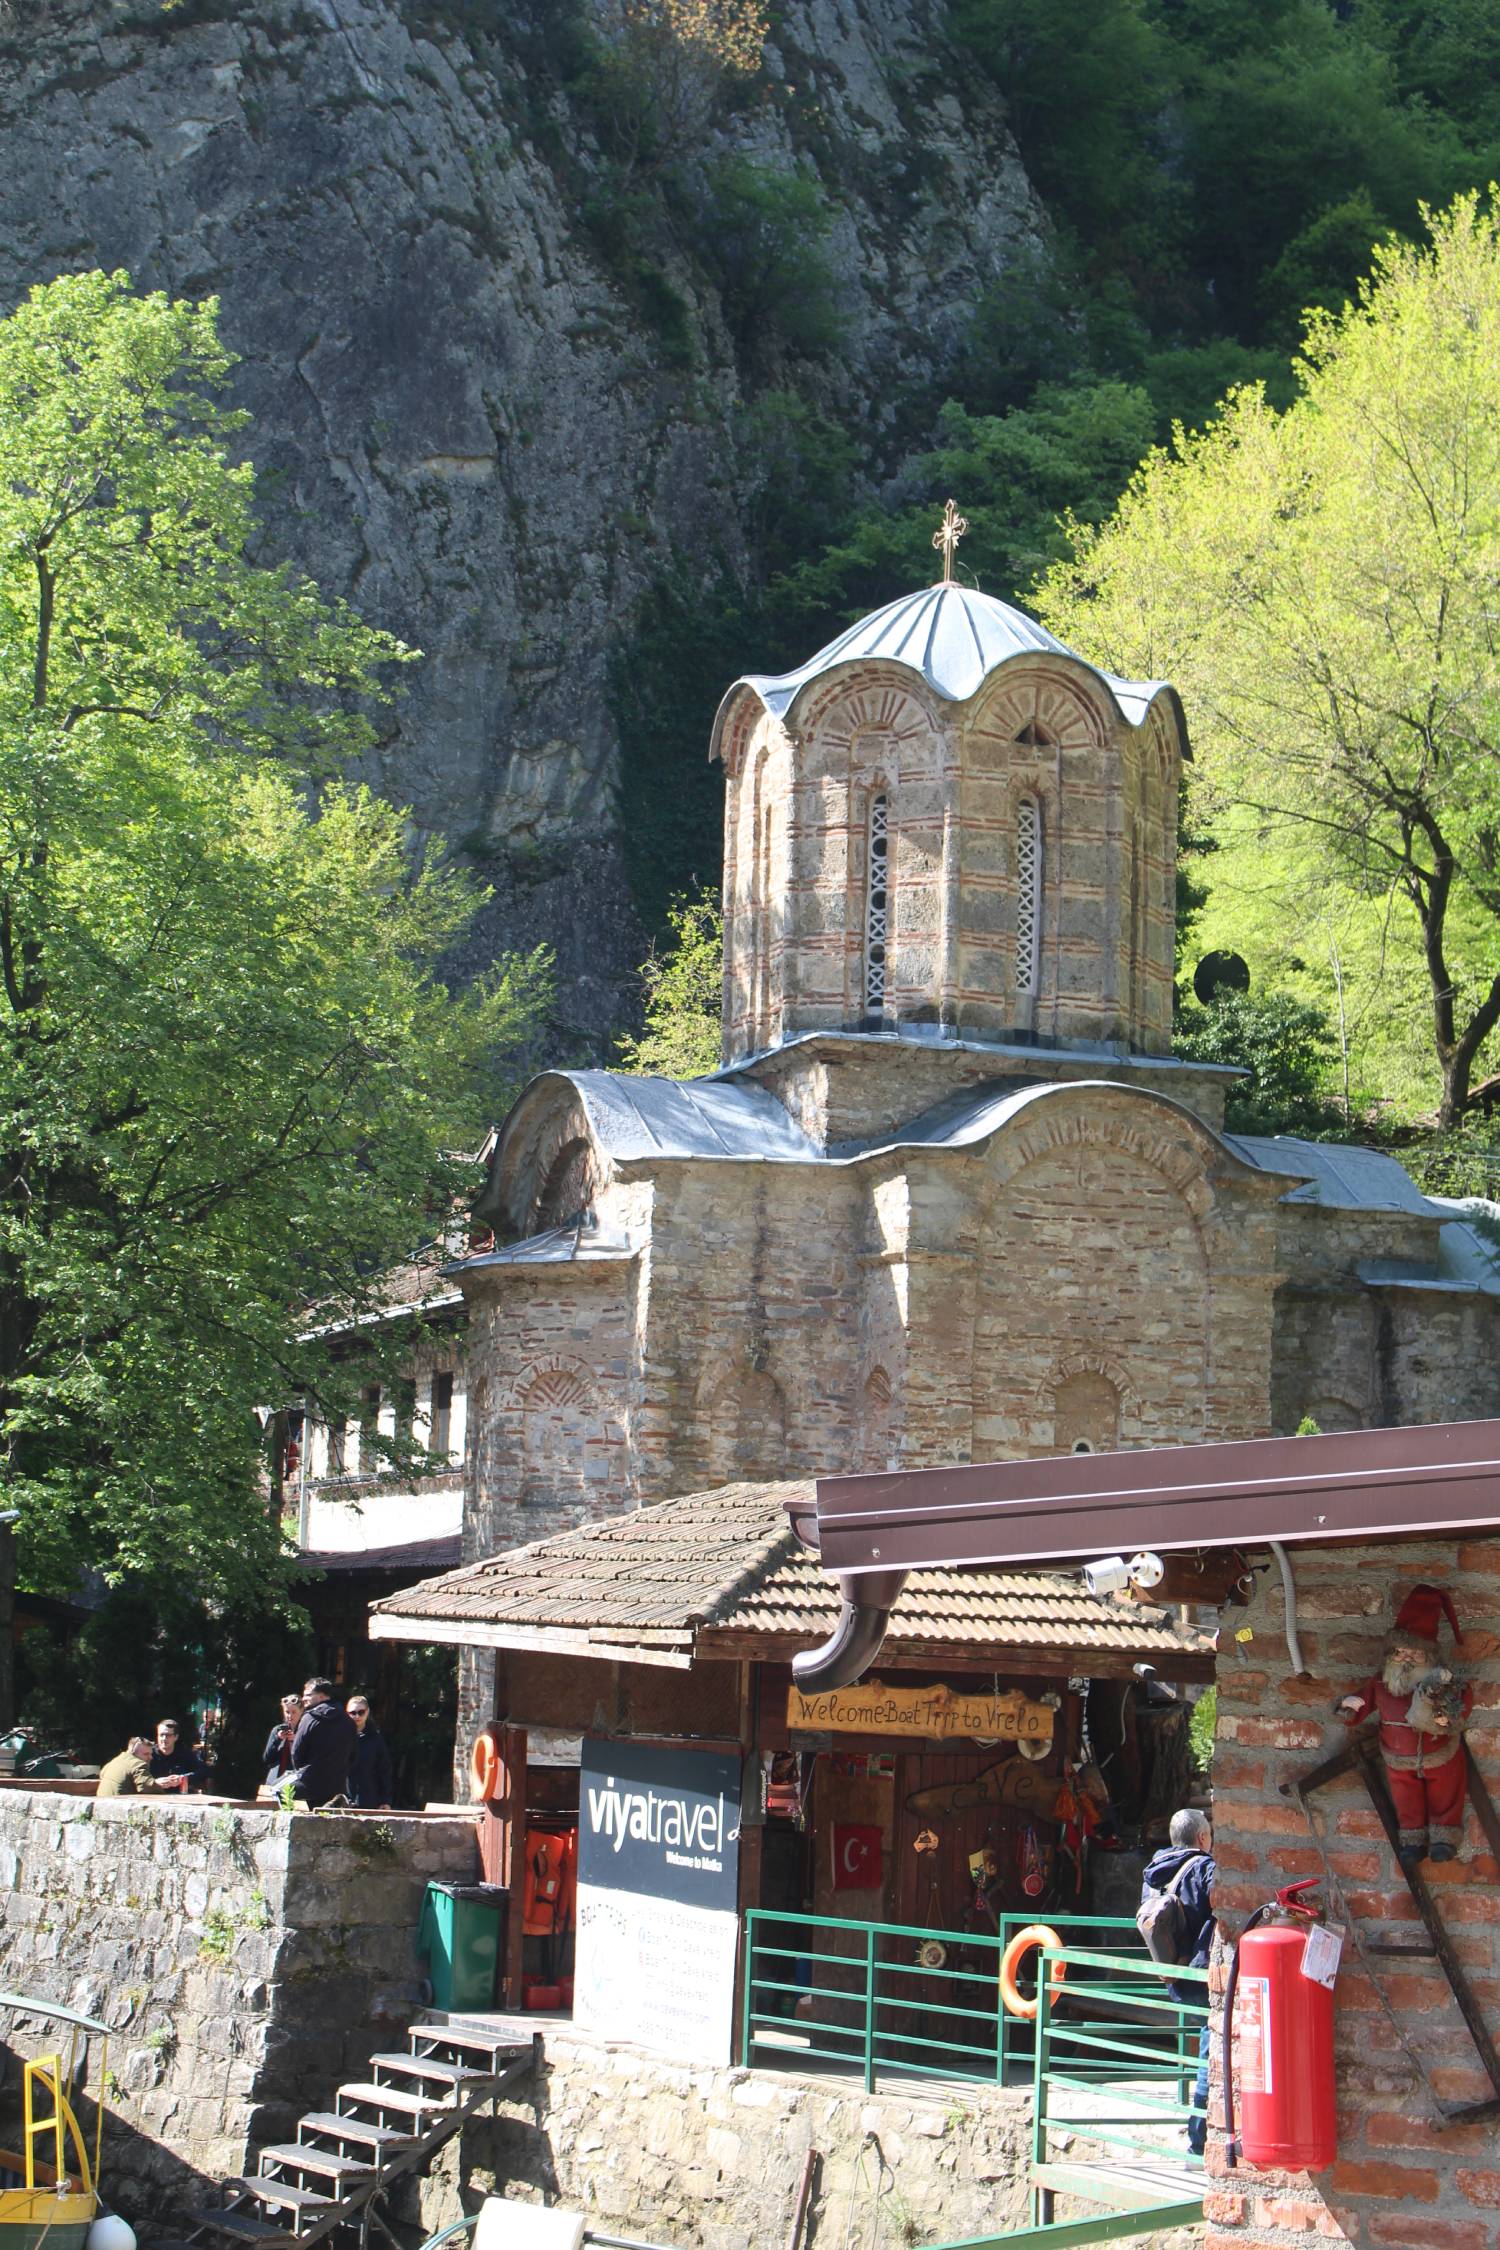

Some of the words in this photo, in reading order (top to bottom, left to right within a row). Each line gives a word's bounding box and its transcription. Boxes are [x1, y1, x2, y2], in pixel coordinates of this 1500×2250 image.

[961, 1703, 982, 1728] to
[986, 1703, 1039, 1733] Vrelo
[588, 1776, 723, 1852] viyatravel
[666, 1851, 694, 1867] Welcome
[694, 1856, 702, 1869] to
